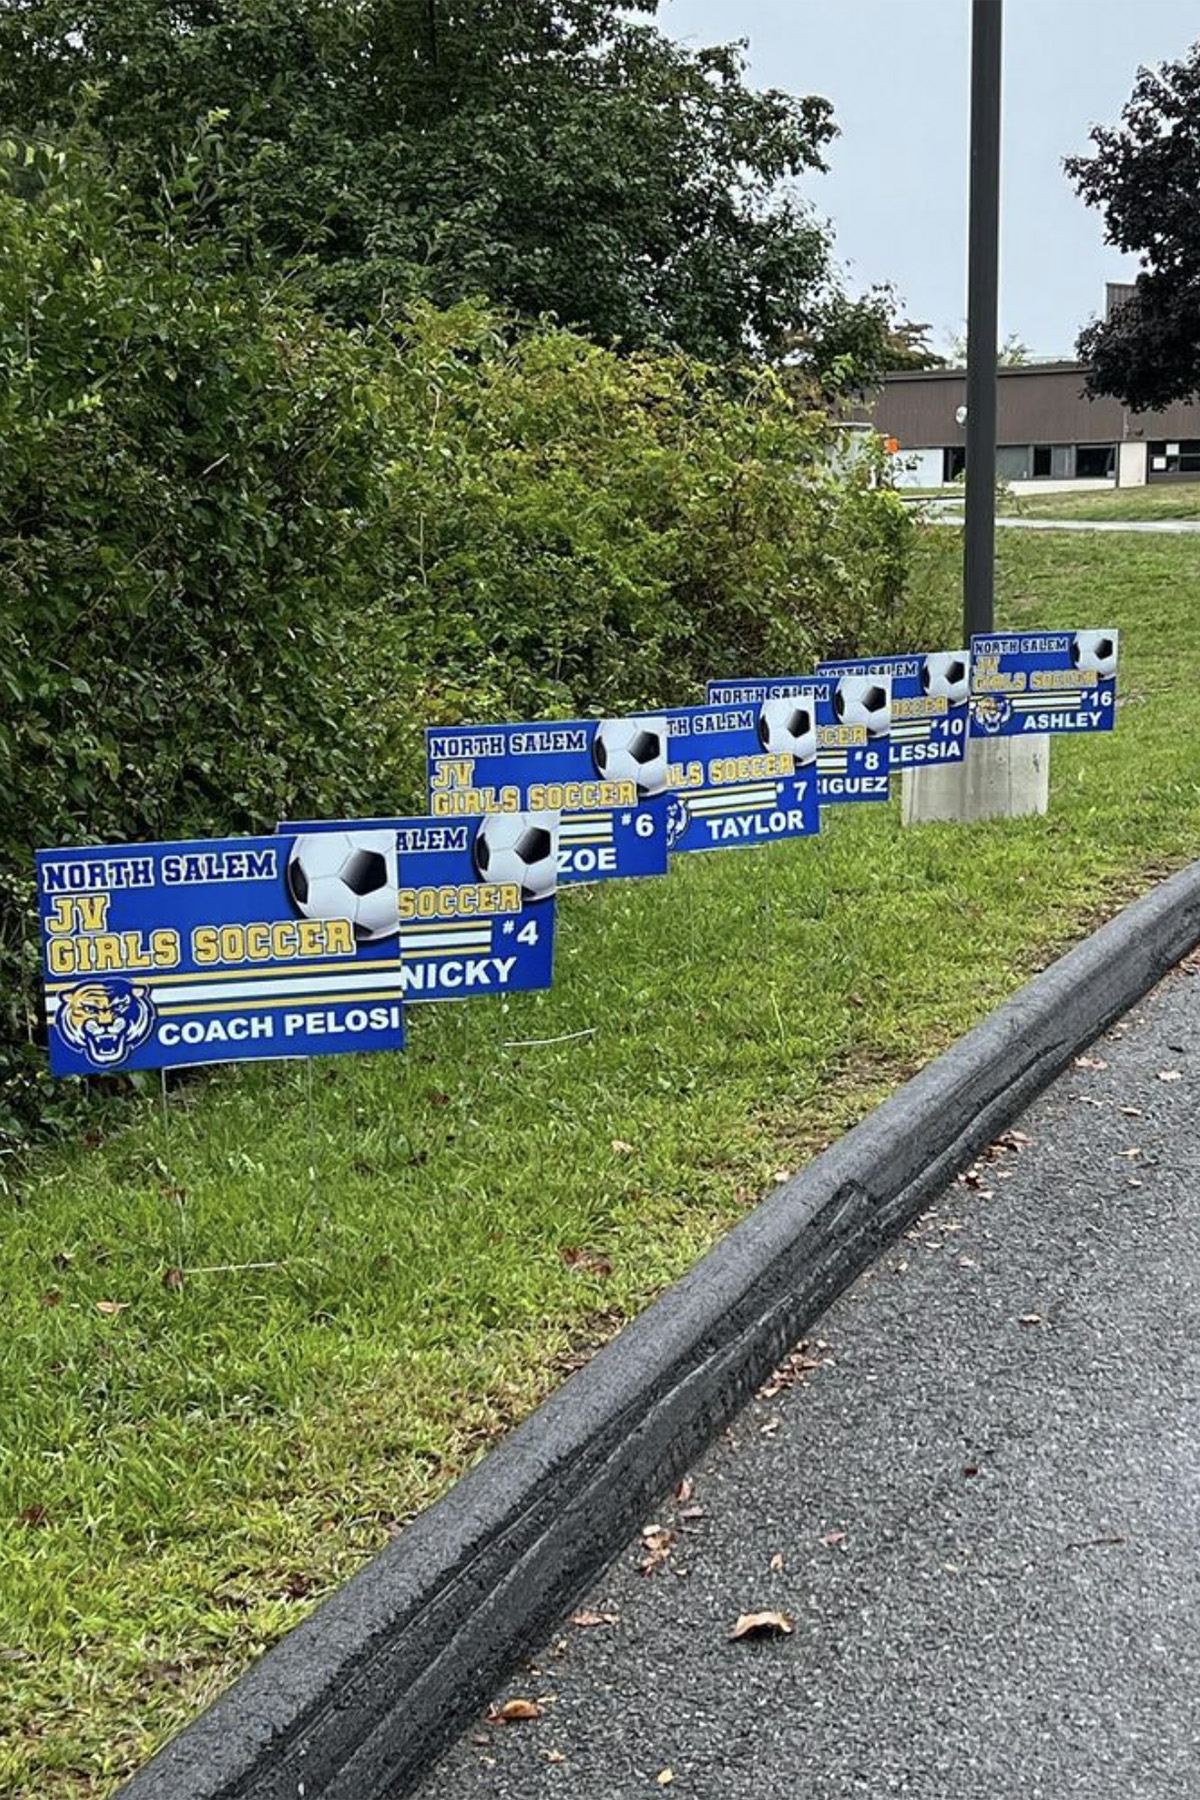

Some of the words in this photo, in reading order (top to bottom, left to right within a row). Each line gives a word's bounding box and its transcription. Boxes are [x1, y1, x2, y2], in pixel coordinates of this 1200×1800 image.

[974, 640, 1019, 655] NORTH
[1020, 637, 1069, 653] SALEM
[710, 687, 766, 704] NORTH
[692, 710, 754, 734] SALEM
[1023, 712, 1102, 730] ASHLEY
[431, 735, 504, 758] NORTH
[511, 730, 586, 753] SALEM
[432, 760, 475, 789] JV
[709, 752, 795, 785] SOCCER
[432, 786, 520, 815] GIRLS
[527, 780, 638, 811] SOCCER
[816, 776, 888, 794] IGUEZ
[621, 813, 654, 837] #6
[707, 810, 804, 840] TAYLOR
[396, 827, 467, 853] ALEM
[43, 858, 155, 892] NORTH
[162, 851, 278, 885] SALEM
[557, 848, 617, 872] ZOE
[46, 893, 110, 934] JV
[398, 883, 522, 919] SOCCER
[502, 920, 538, 945] #4
[46, 929, 181, 976] GIRLS
[192, 919, 356, 965] SOCCER
[402, 957, 517, 991] NICKY
[157, 1016, 273, 1046] COACH
[285, 1007, 399, 1036] PELOSI
